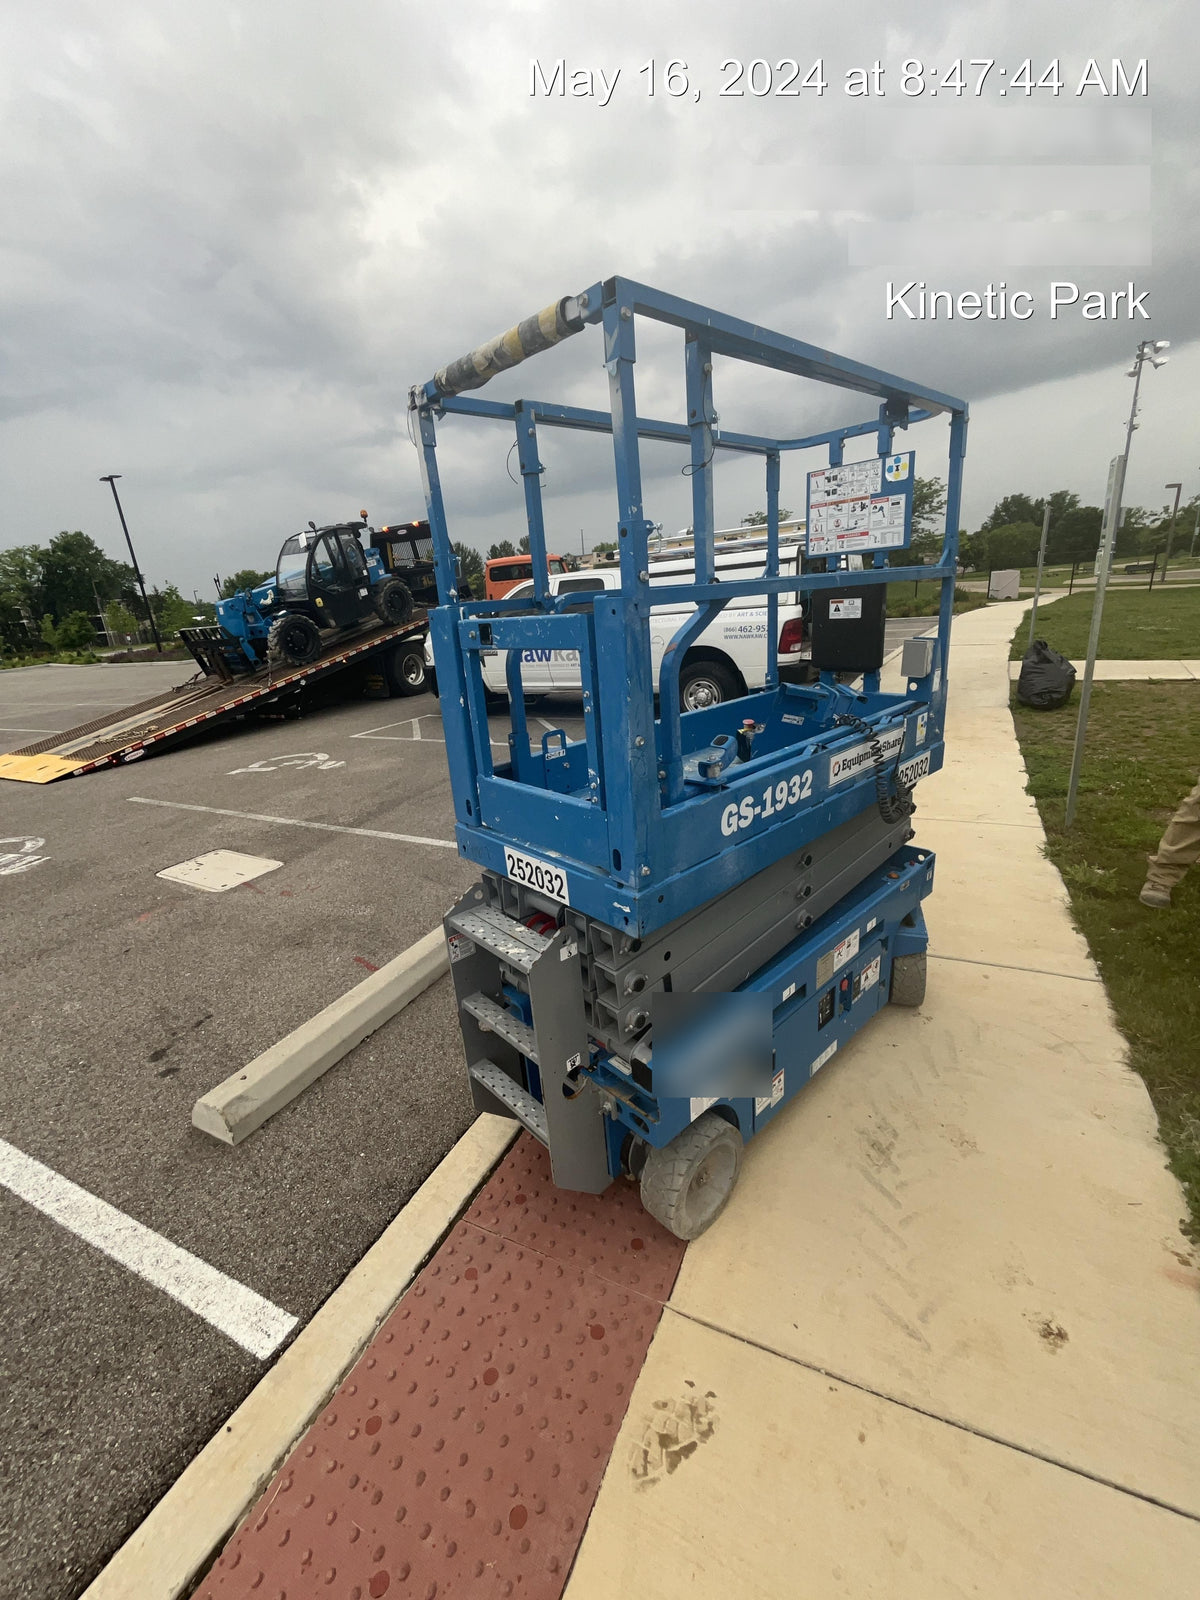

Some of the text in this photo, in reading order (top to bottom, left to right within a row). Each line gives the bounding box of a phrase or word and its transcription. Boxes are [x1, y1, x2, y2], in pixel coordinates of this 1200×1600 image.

[738, 624, 768, 633] 462-95
[720, 769, 813, 837] GS-1932
[507, 853, 566, 900] 252032
